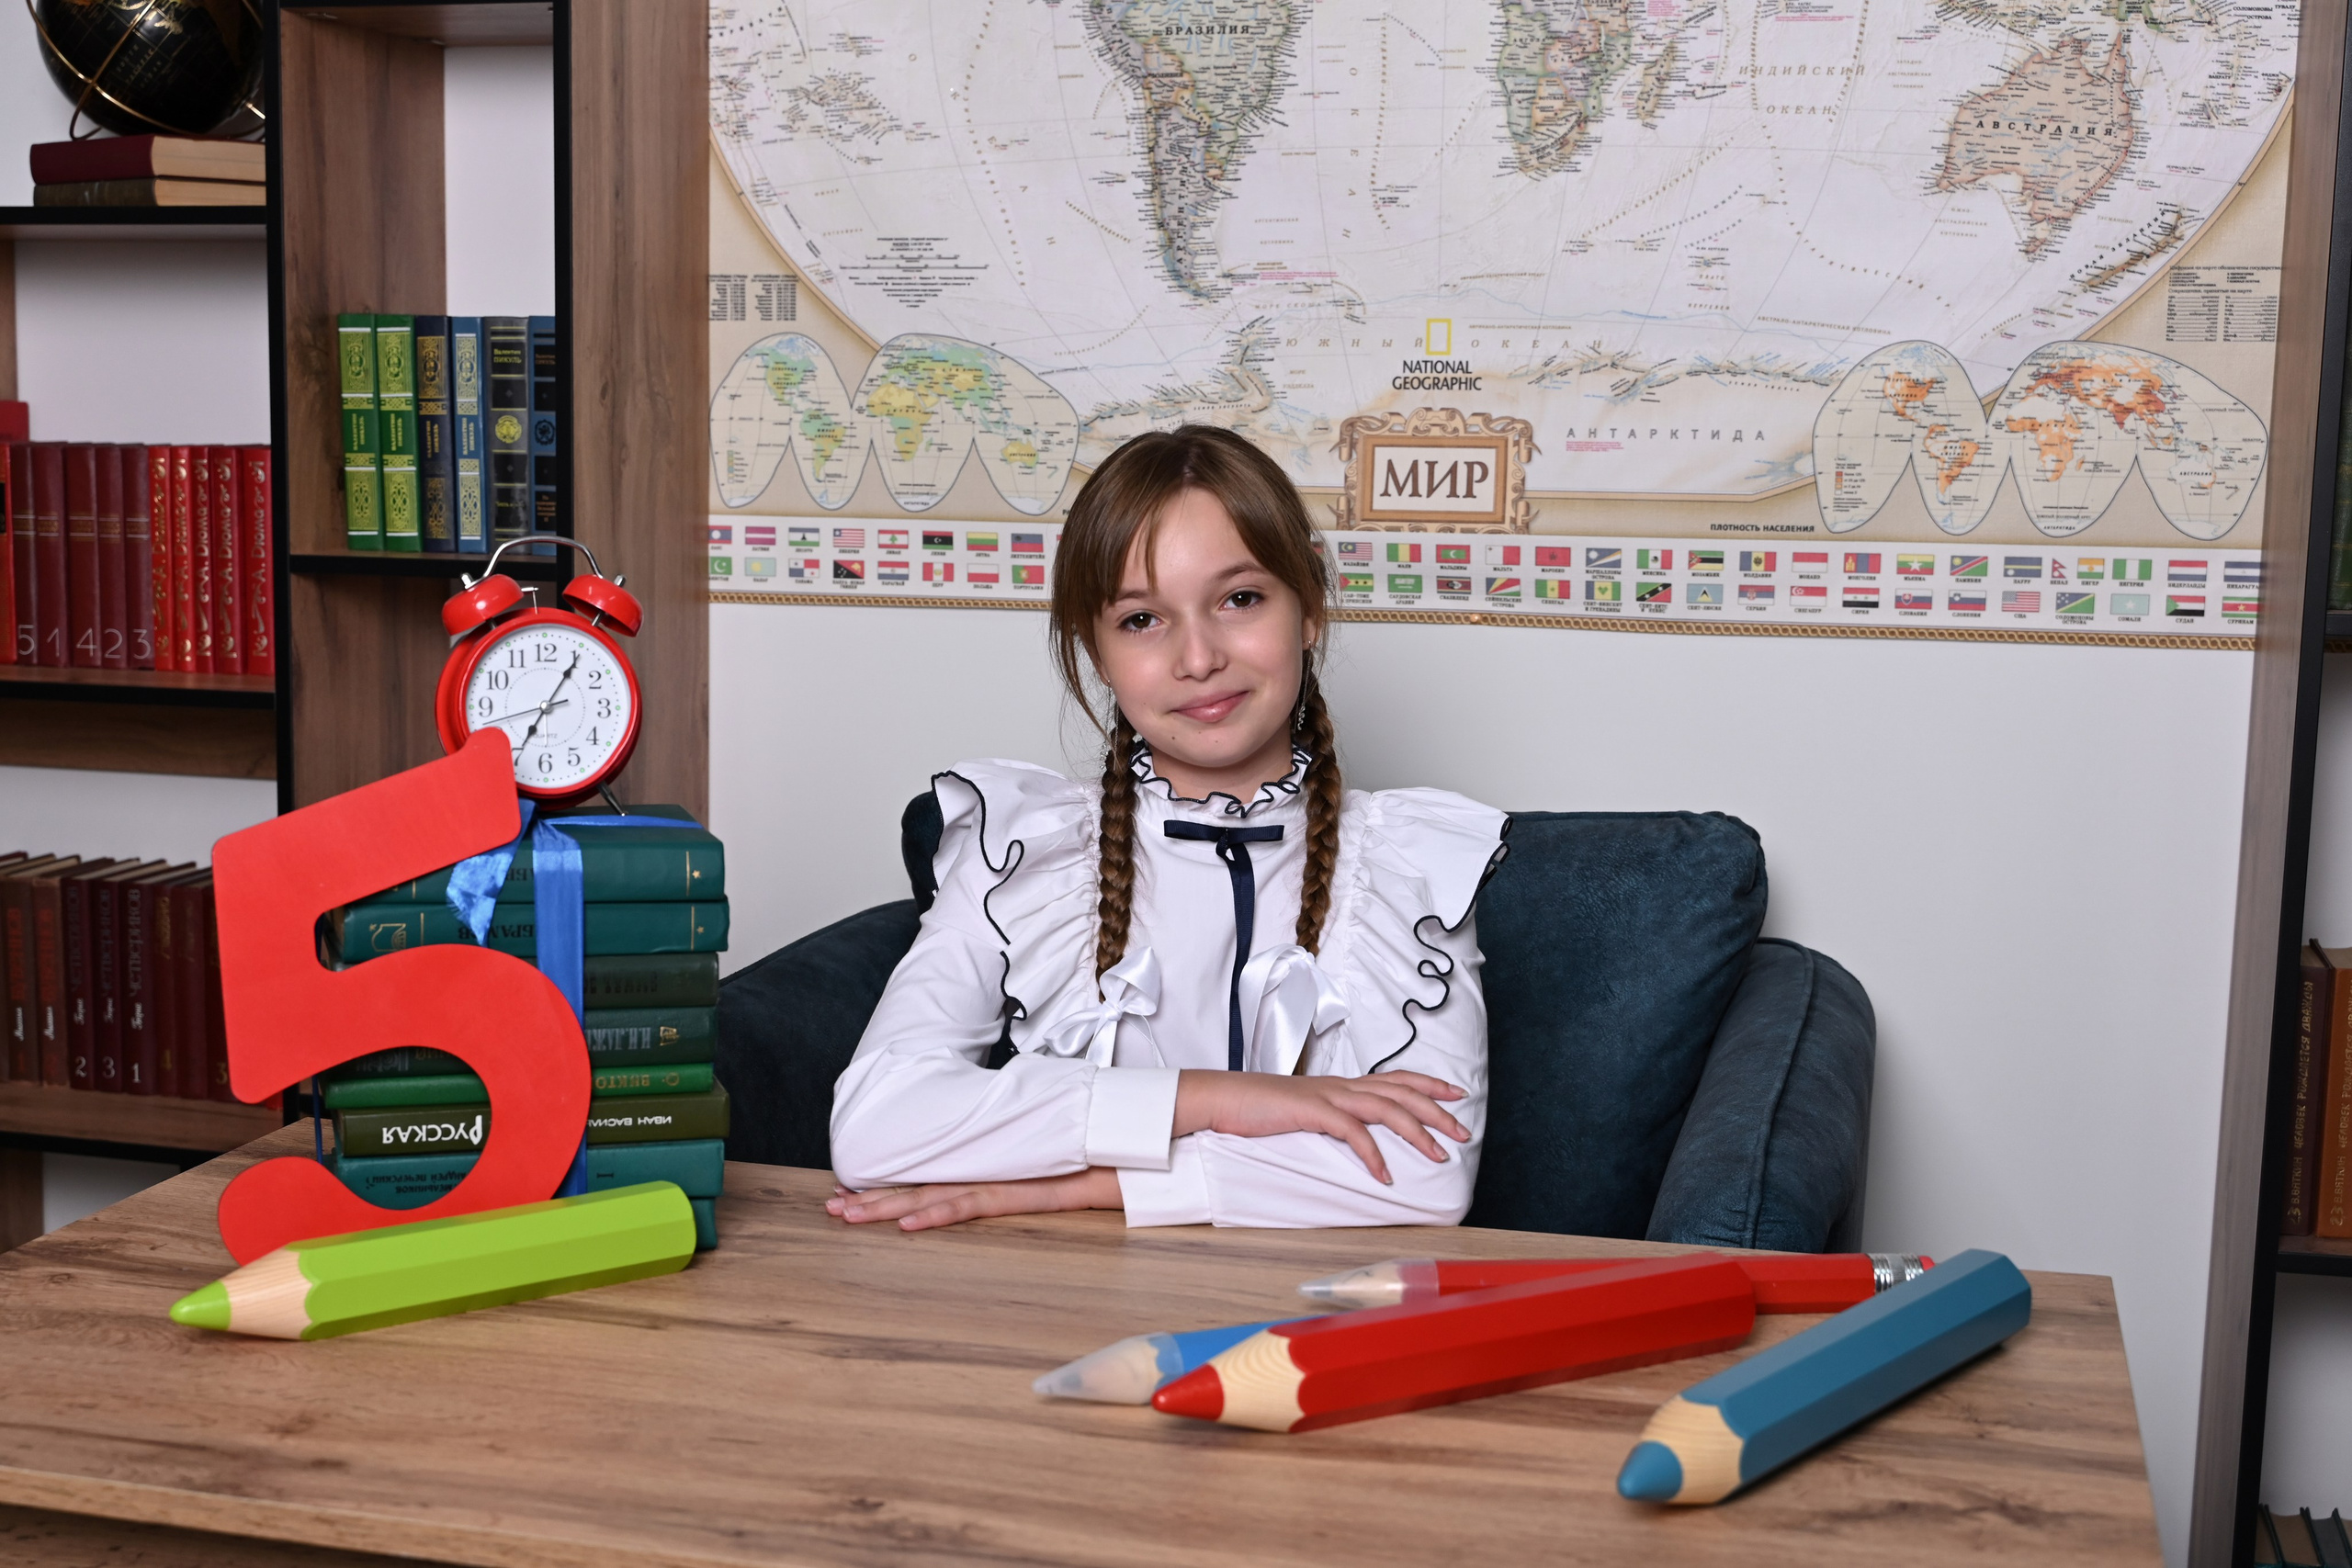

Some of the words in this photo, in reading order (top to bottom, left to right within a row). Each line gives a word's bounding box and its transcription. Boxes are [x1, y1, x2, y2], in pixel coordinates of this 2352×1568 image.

[1165, 26, 1250, 36] БРАЗИЛИЯ
[1739, 64, 1865, 76] ИНДИЙСКИЙ
[1767, 105, 1832, 115] ОКЕАН
[1976, 119, 2112, 136] АВСТРАЛИЯ
[1402, 360, 1473, 375] NATIONAL
[1392, 376, 1483, 391] GEOGRAPHIC
[1566, 428, 1765, 441] АНТАРКТИДА
[1379, 459, 1490, 500] МИР
[195, 507, 209, 557] Дюма
[218, 508, 233, 558] Дюма
[252, 509, 266, 558] Дюма
[1710, 524, 1760, 532] ПЛОТНОСТЬ
[1763, 525, 1815, 533] НАСЕЛЕНИЯ
[17, 624, 35, 656] 5
[47, 627, 60, 658] 1
[75, 627, 97, 657] 4
[104, 627, 123, 659] 2
[132, 628, 152, 660] 3
[508, 649, 526, 668] 11
[534, 643, 558, 662] 12
[571, 649, 580, 669] 1
[486, 669, 509, 690] 10
[588, 670, 603, 690] 2
[479, 696, 493, 717] 9
[597, 698, 611, 718] 3
[585, 726, 600, 746] 4
[511, 747, 524, 767] 7
[538, 752, 553, 774] 6
[567, 747, 581, 767] 5
[458, 924, 534, 939] БРАМВ
[129, 888, 143, 997] ЧЕТВЕРИКОВ
[211, 727, 591, 1266] 5
[2301, 981, 2313, 1032] ДВАЖДЫ
[75, 1056, 87, 1077] 2
[103, 1056, 116, 1079] 3
[132, 1063, 141, 1084] 1
[2297, 1035, 2311, 1100] РОЖДАЕТСЯ
[594, 1073, 650, 1089] ВИКТО
[381, 1114, 483, 1145] РУССКАЯ
[638, 1115, 672, 1125] ИВАН
[2294, 1105, 2306, 1149] ЧЕЛОВЕК
[2338, 1103, 2350, 1148] ЧЕЛОВЕК
